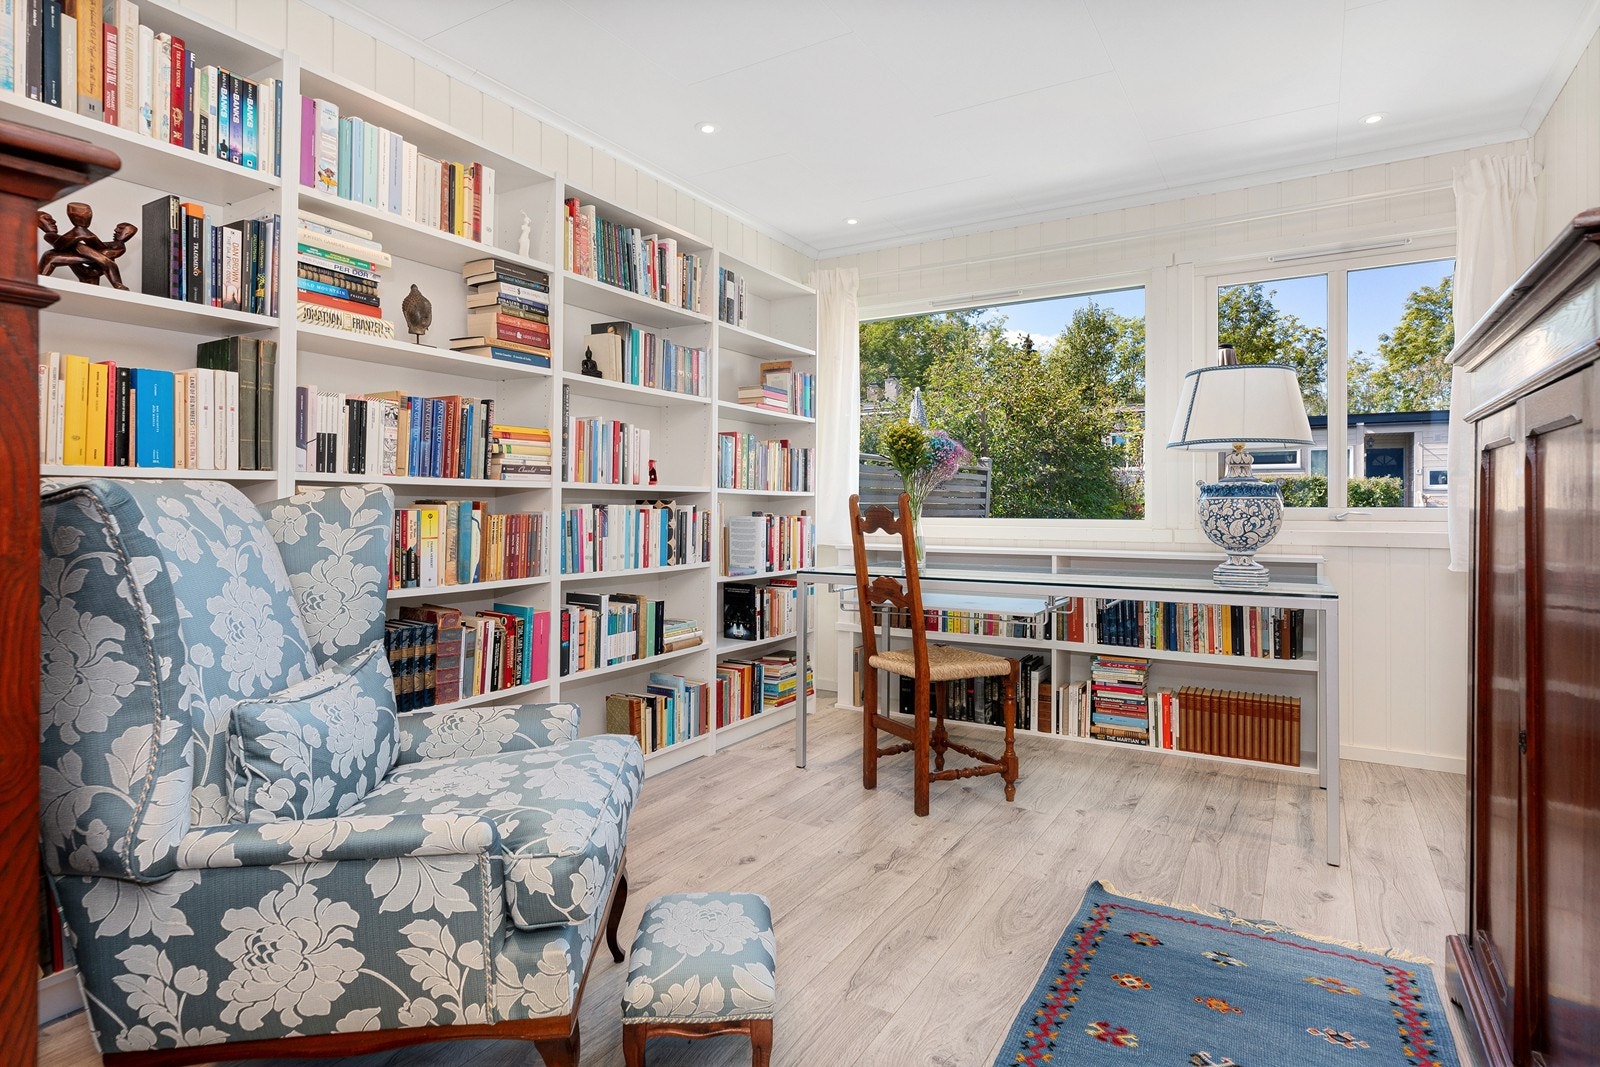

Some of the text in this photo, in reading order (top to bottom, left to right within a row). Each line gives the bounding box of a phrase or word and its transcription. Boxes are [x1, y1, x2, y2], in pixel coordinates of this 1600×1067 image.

[107, 32, 117, 42] THE
[220, 87, 228, 118] BANKS
[232, 93, 240, 124] BANKS
[246, 98, 254, 128] BANKS
[333, 264, 350, 273] PER
[316, 285, 346, 296] MOUNTAIN
[303, 307, 384, 334] JONATHAN FRANZEN
[1116, 736, 1140, 744] MARTIAN
